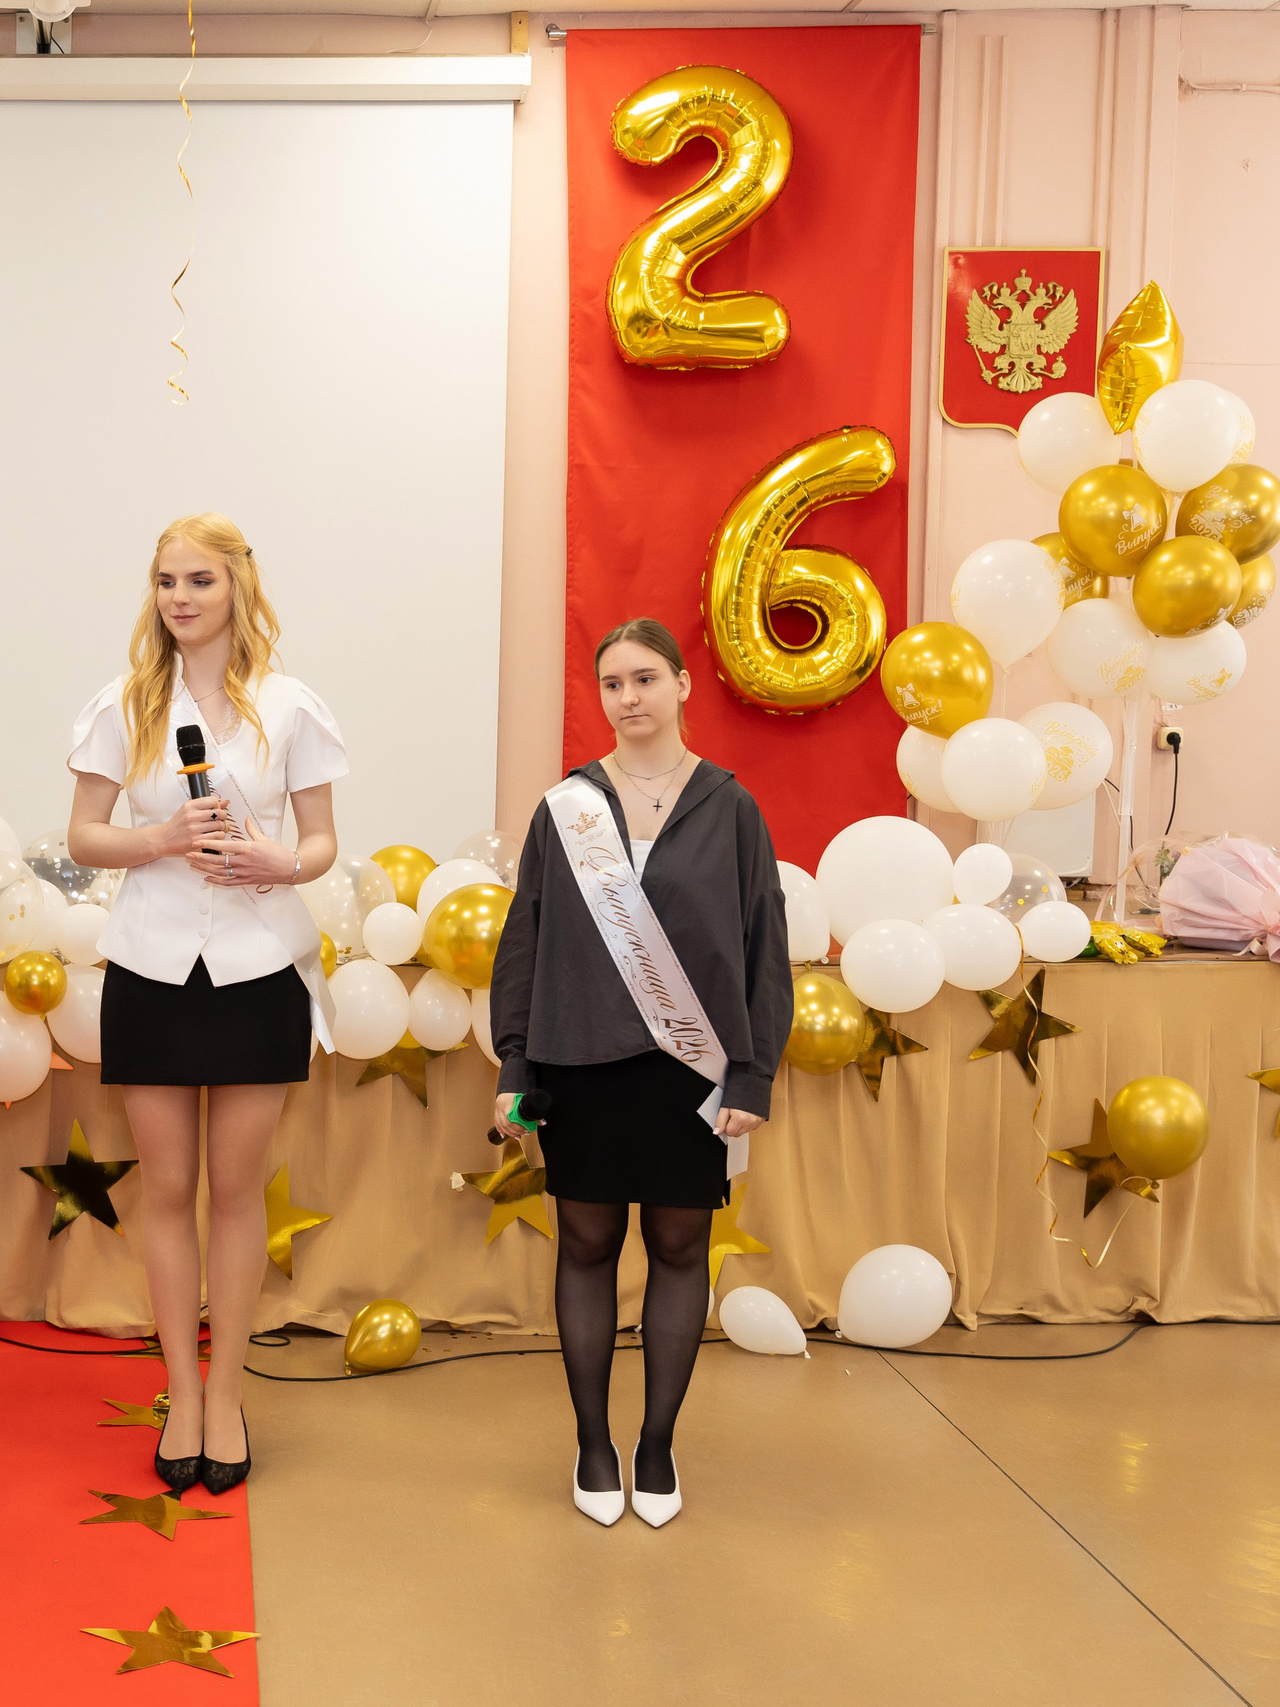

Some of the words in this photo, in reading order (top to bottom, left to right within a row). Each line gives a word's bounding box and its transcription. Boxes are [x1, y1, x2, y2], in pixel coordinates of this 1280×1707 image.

[606, 64, 795, 371] 2
[700, 425, 896, 715] 6
[1115, 513, 1162, 555] Выпуск!
[1046, 762, 1068, 782] 026
[578, 846, 677, 1012] Выпускница
[661, 1016, 716, 1063] 2026
